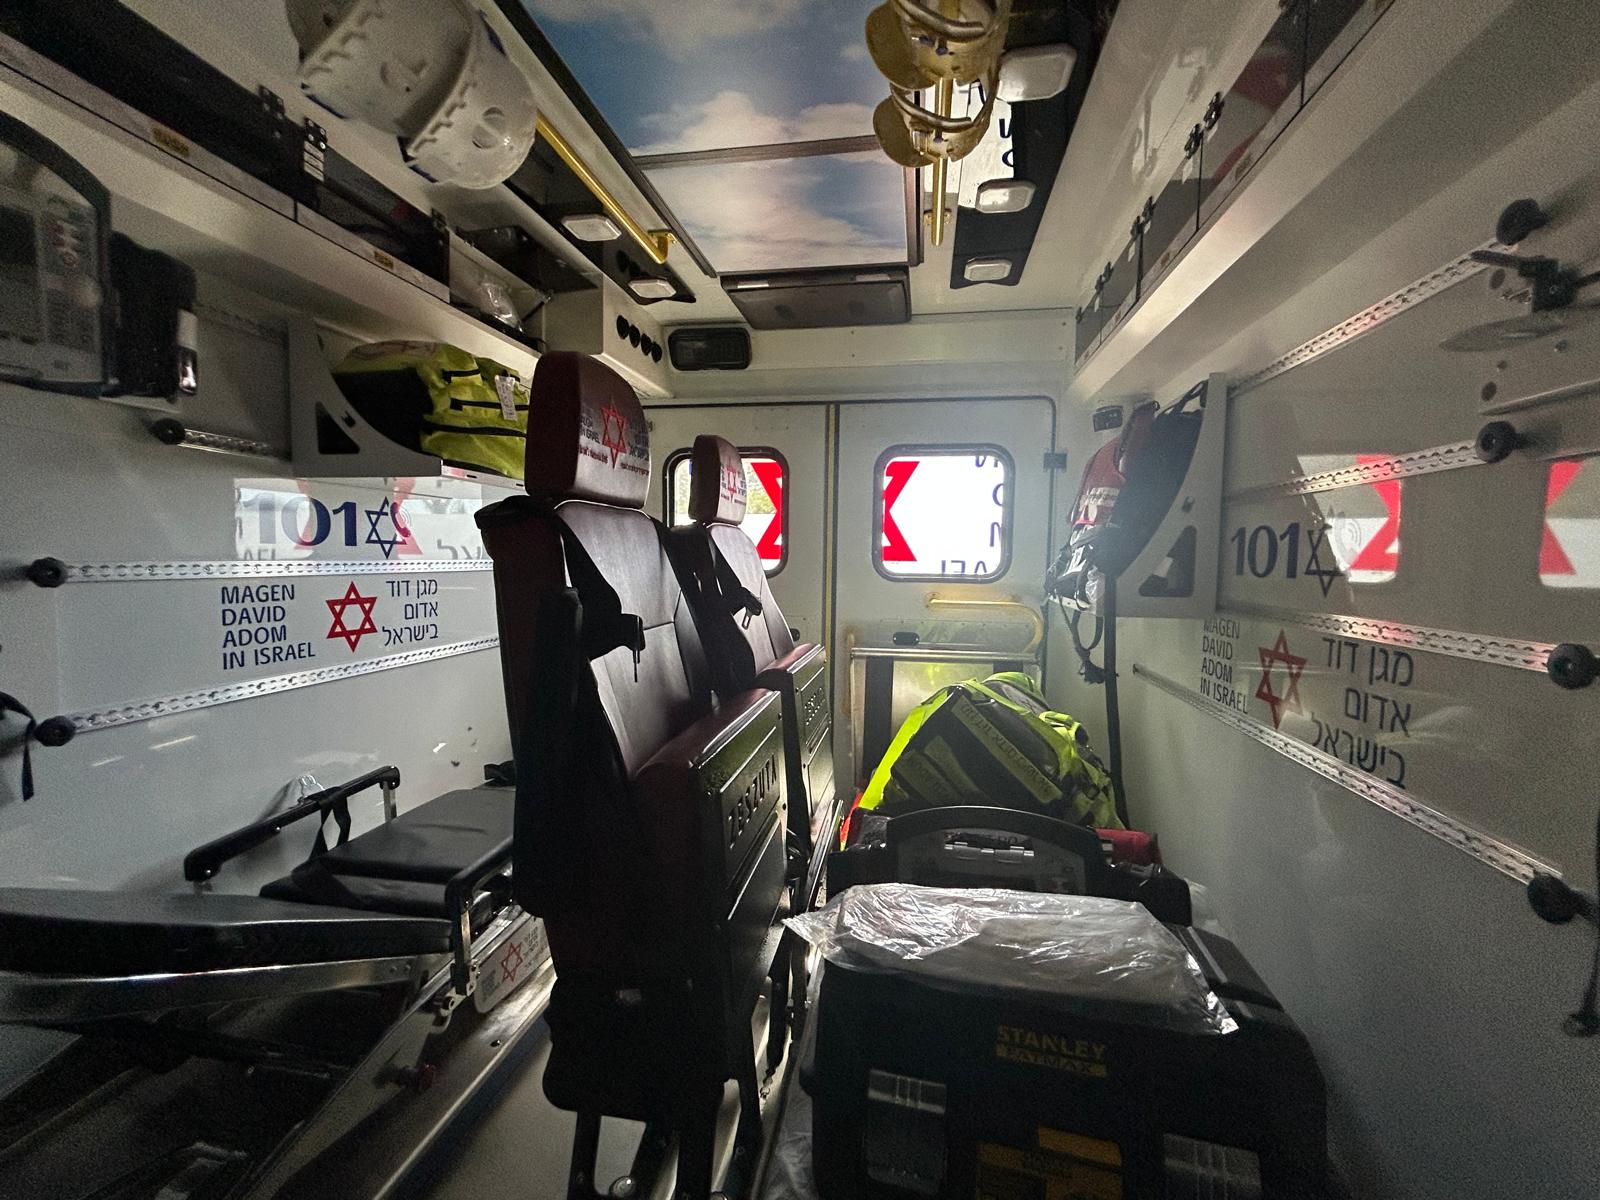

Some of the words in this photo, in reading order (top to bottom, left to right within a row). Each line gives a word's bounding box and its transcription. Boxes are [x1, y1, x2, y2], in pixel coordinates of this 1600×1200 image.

[243, 495, 357, 546] 101
[1231, 522, 1300, 579] 101
[221, 584, 295, 604] MAGEN
[385, 580, 411, 597] דוד
[416, 579, 438, 599] מגן
[221, 605, 286, 626] DAVID
[404, 601, 438, 620] אדום
[223, 625, 287, 648] ADOM
[382, 623, 439, 647] בישראל
[1202, 635, 1233, 660] DAVID
[222, 650, 245, 670] IN
[254, 642, 316, 666] ISRAEL
[1322, 637, 1360, 674] דוד
[1368, 646, 1414, 687] מגן
[1201, 657, 1233, 684] ADOM
[1200, 677, 1211, 697] IN
[1213, 682, 1248, 715] ISRAEL
[1345, 687, 1412, 738] אדום
[1310, 711, 1406, 790] בישראל
[998, 1024, 1105, 1060] STANLEY
